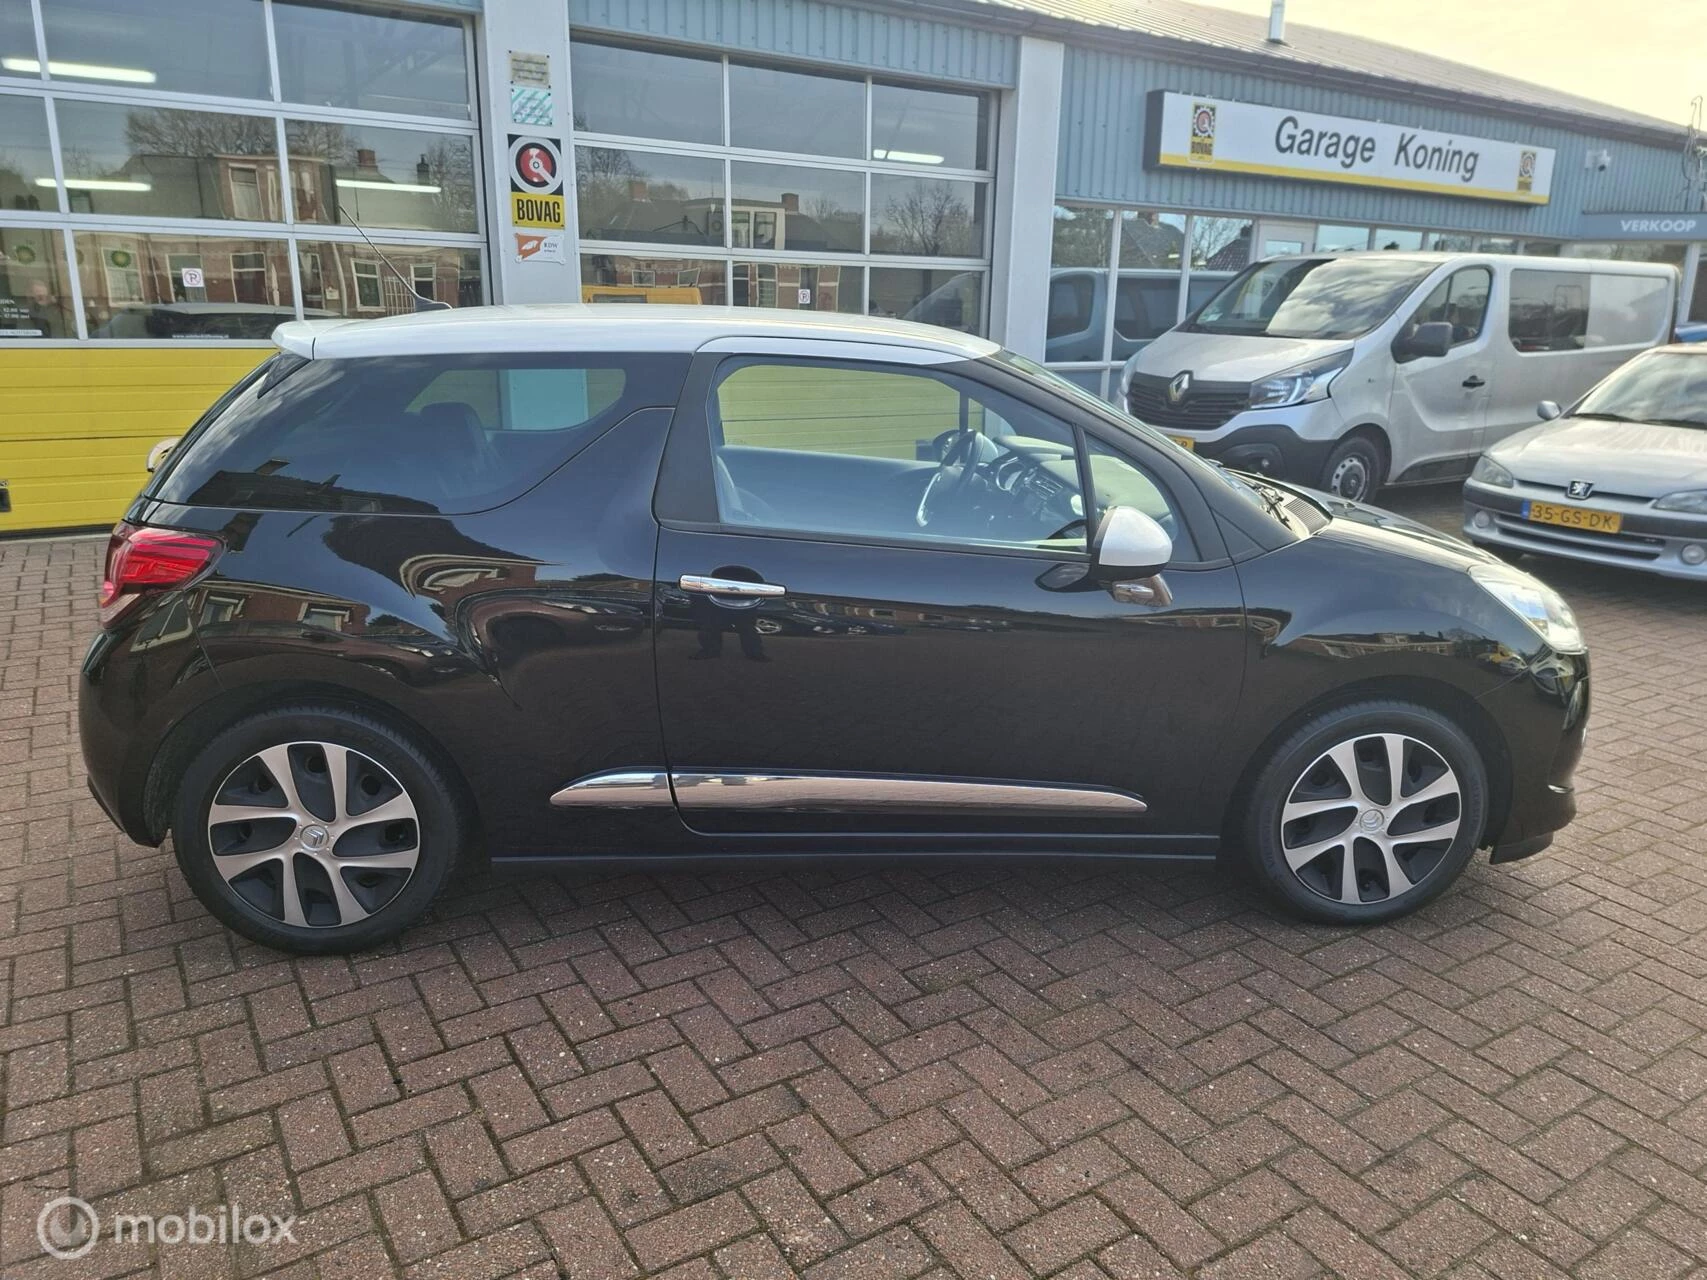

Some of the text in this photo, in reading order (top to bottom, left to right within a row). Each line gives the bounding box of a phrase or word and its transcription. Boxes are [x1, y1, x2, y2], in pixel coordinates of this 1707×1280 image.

[1275, 115, 1479, 183] Garage Koning
[516, 198, 561, 223] BOVAG
[1621, 219, 1697, 232] VERKOOP
[1532, 504, 1613, 530] 35-GS-DK
